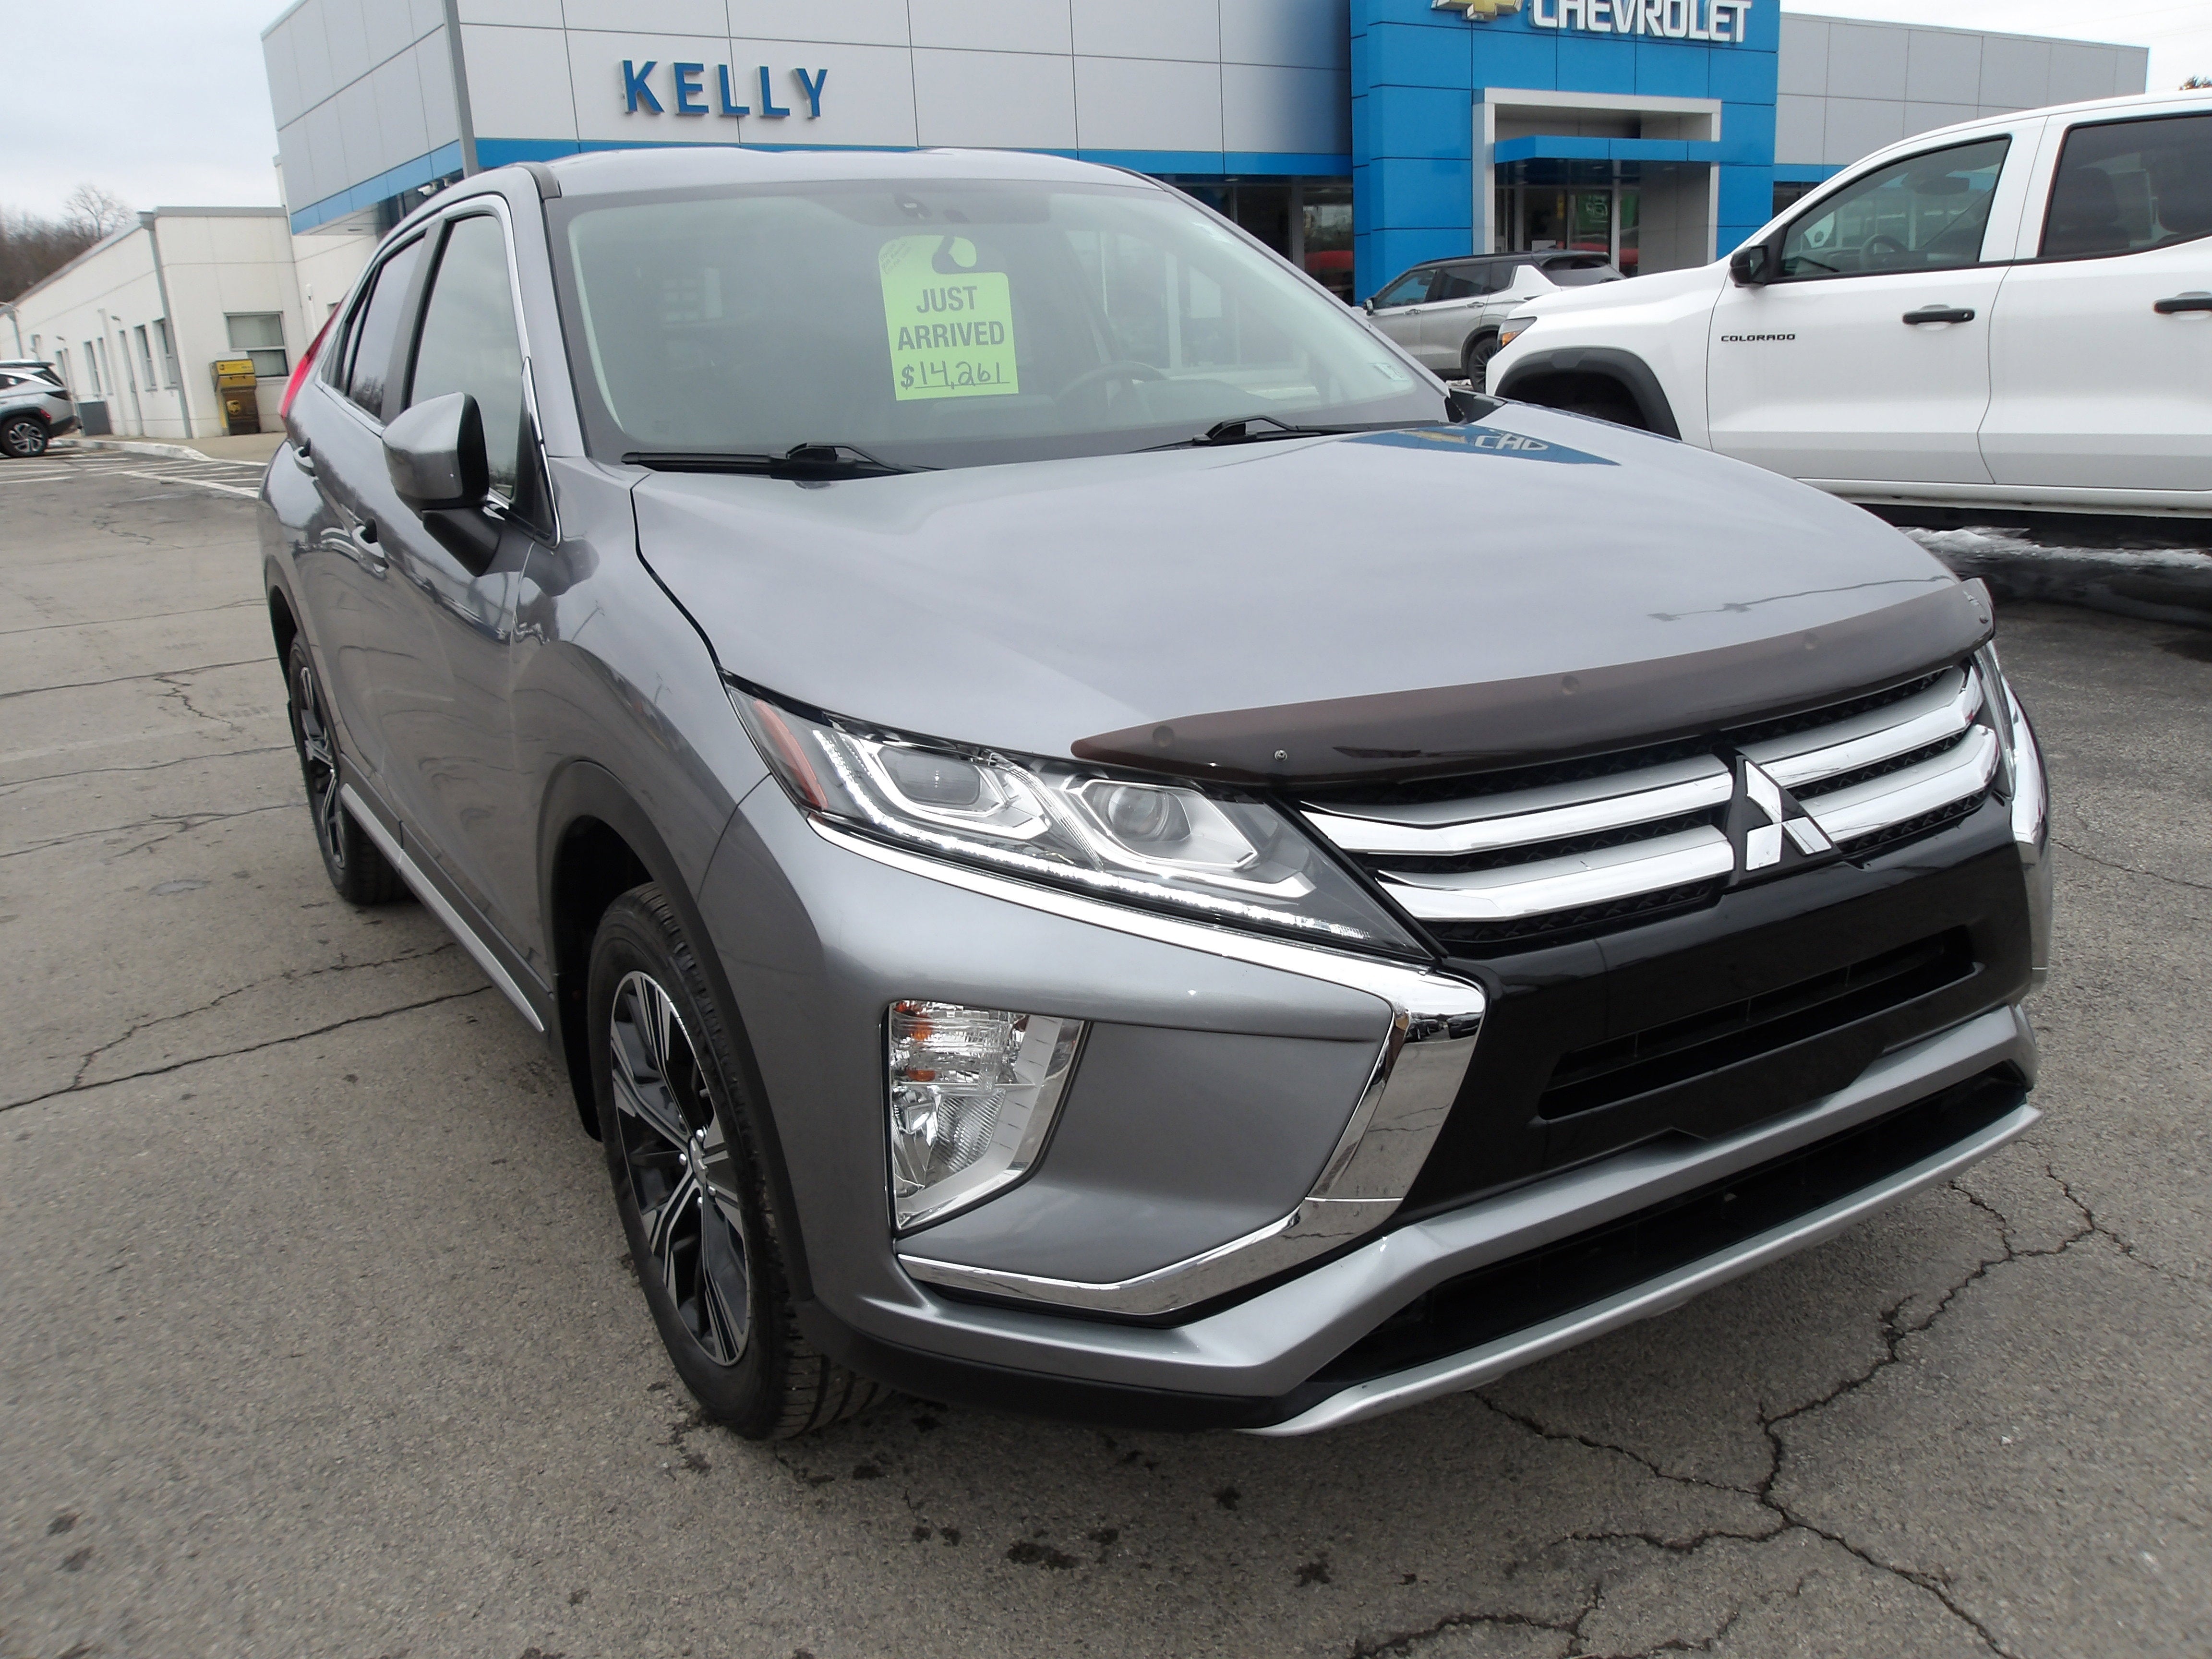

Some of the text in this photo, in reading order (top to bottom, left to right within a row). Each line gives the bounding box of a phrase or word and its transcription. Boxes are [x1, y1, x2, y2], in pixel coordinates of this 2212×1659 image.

[1530, 0, 1752, 43] CHEVROLET
[622, 59, 828, 120] KELLY
[916, 286, 978, 314] JUST
[897, 321, 1005, 351] ARRIVED
[1720, 334, 1797, 342] COLORADO
[900, 360, 1001, 390] $14,261
